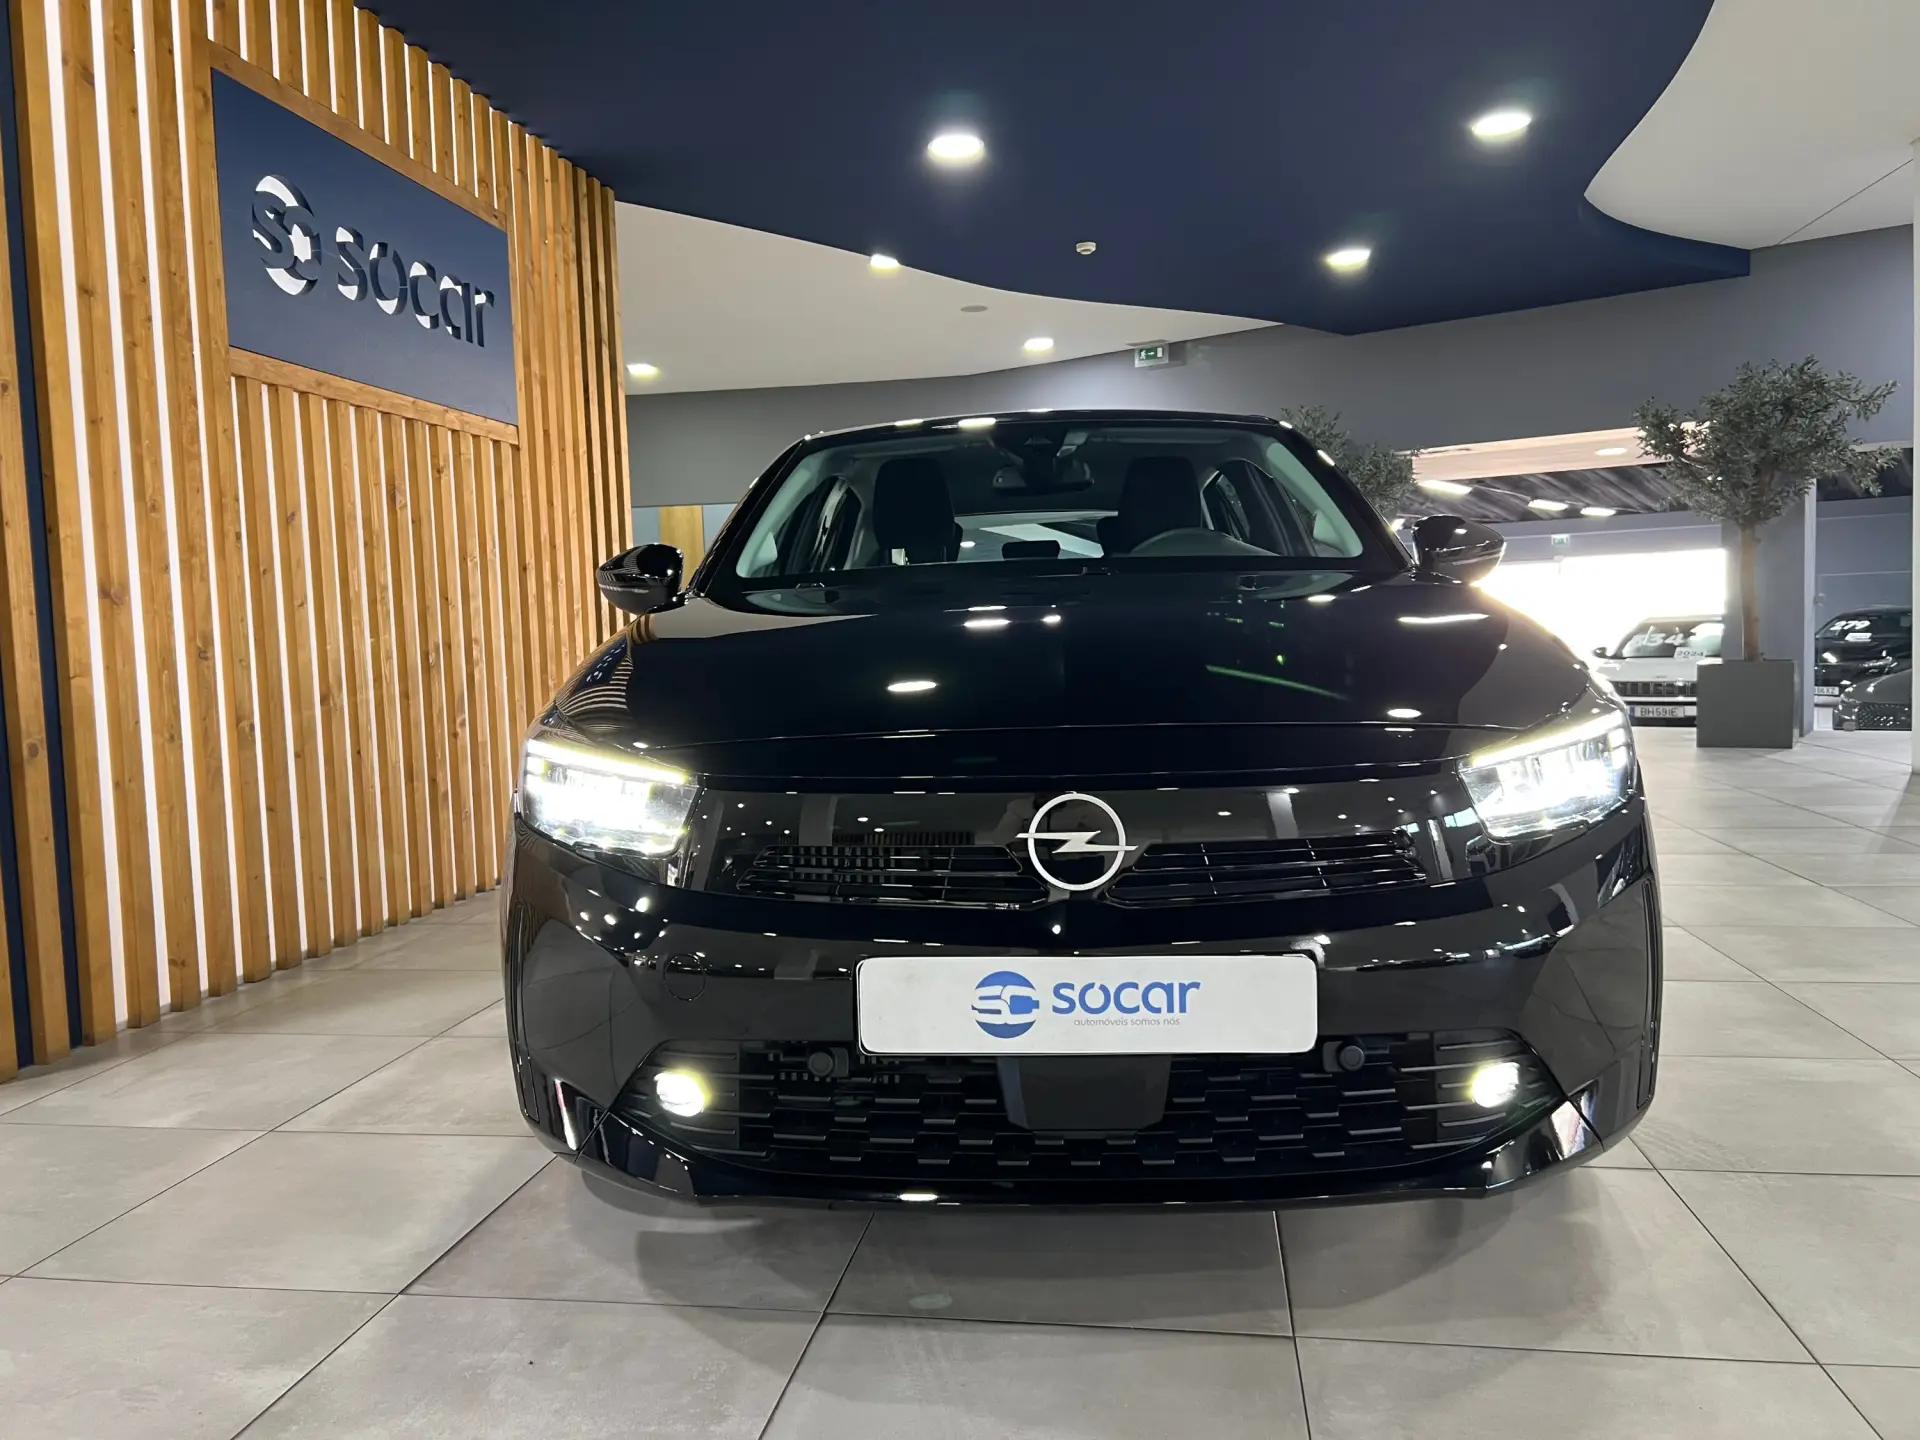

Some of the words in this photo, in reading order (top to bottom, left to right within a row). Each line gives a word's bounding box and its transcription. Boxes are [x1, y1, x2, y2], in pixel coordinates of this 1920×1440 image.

[1052, 981, 1201, 1014] socar
[1073, 1016, 1128, 1027] automóveis
[1130, 1017, 1161, 1027] somos
[1163, 1016, 1181, 1027] nós
